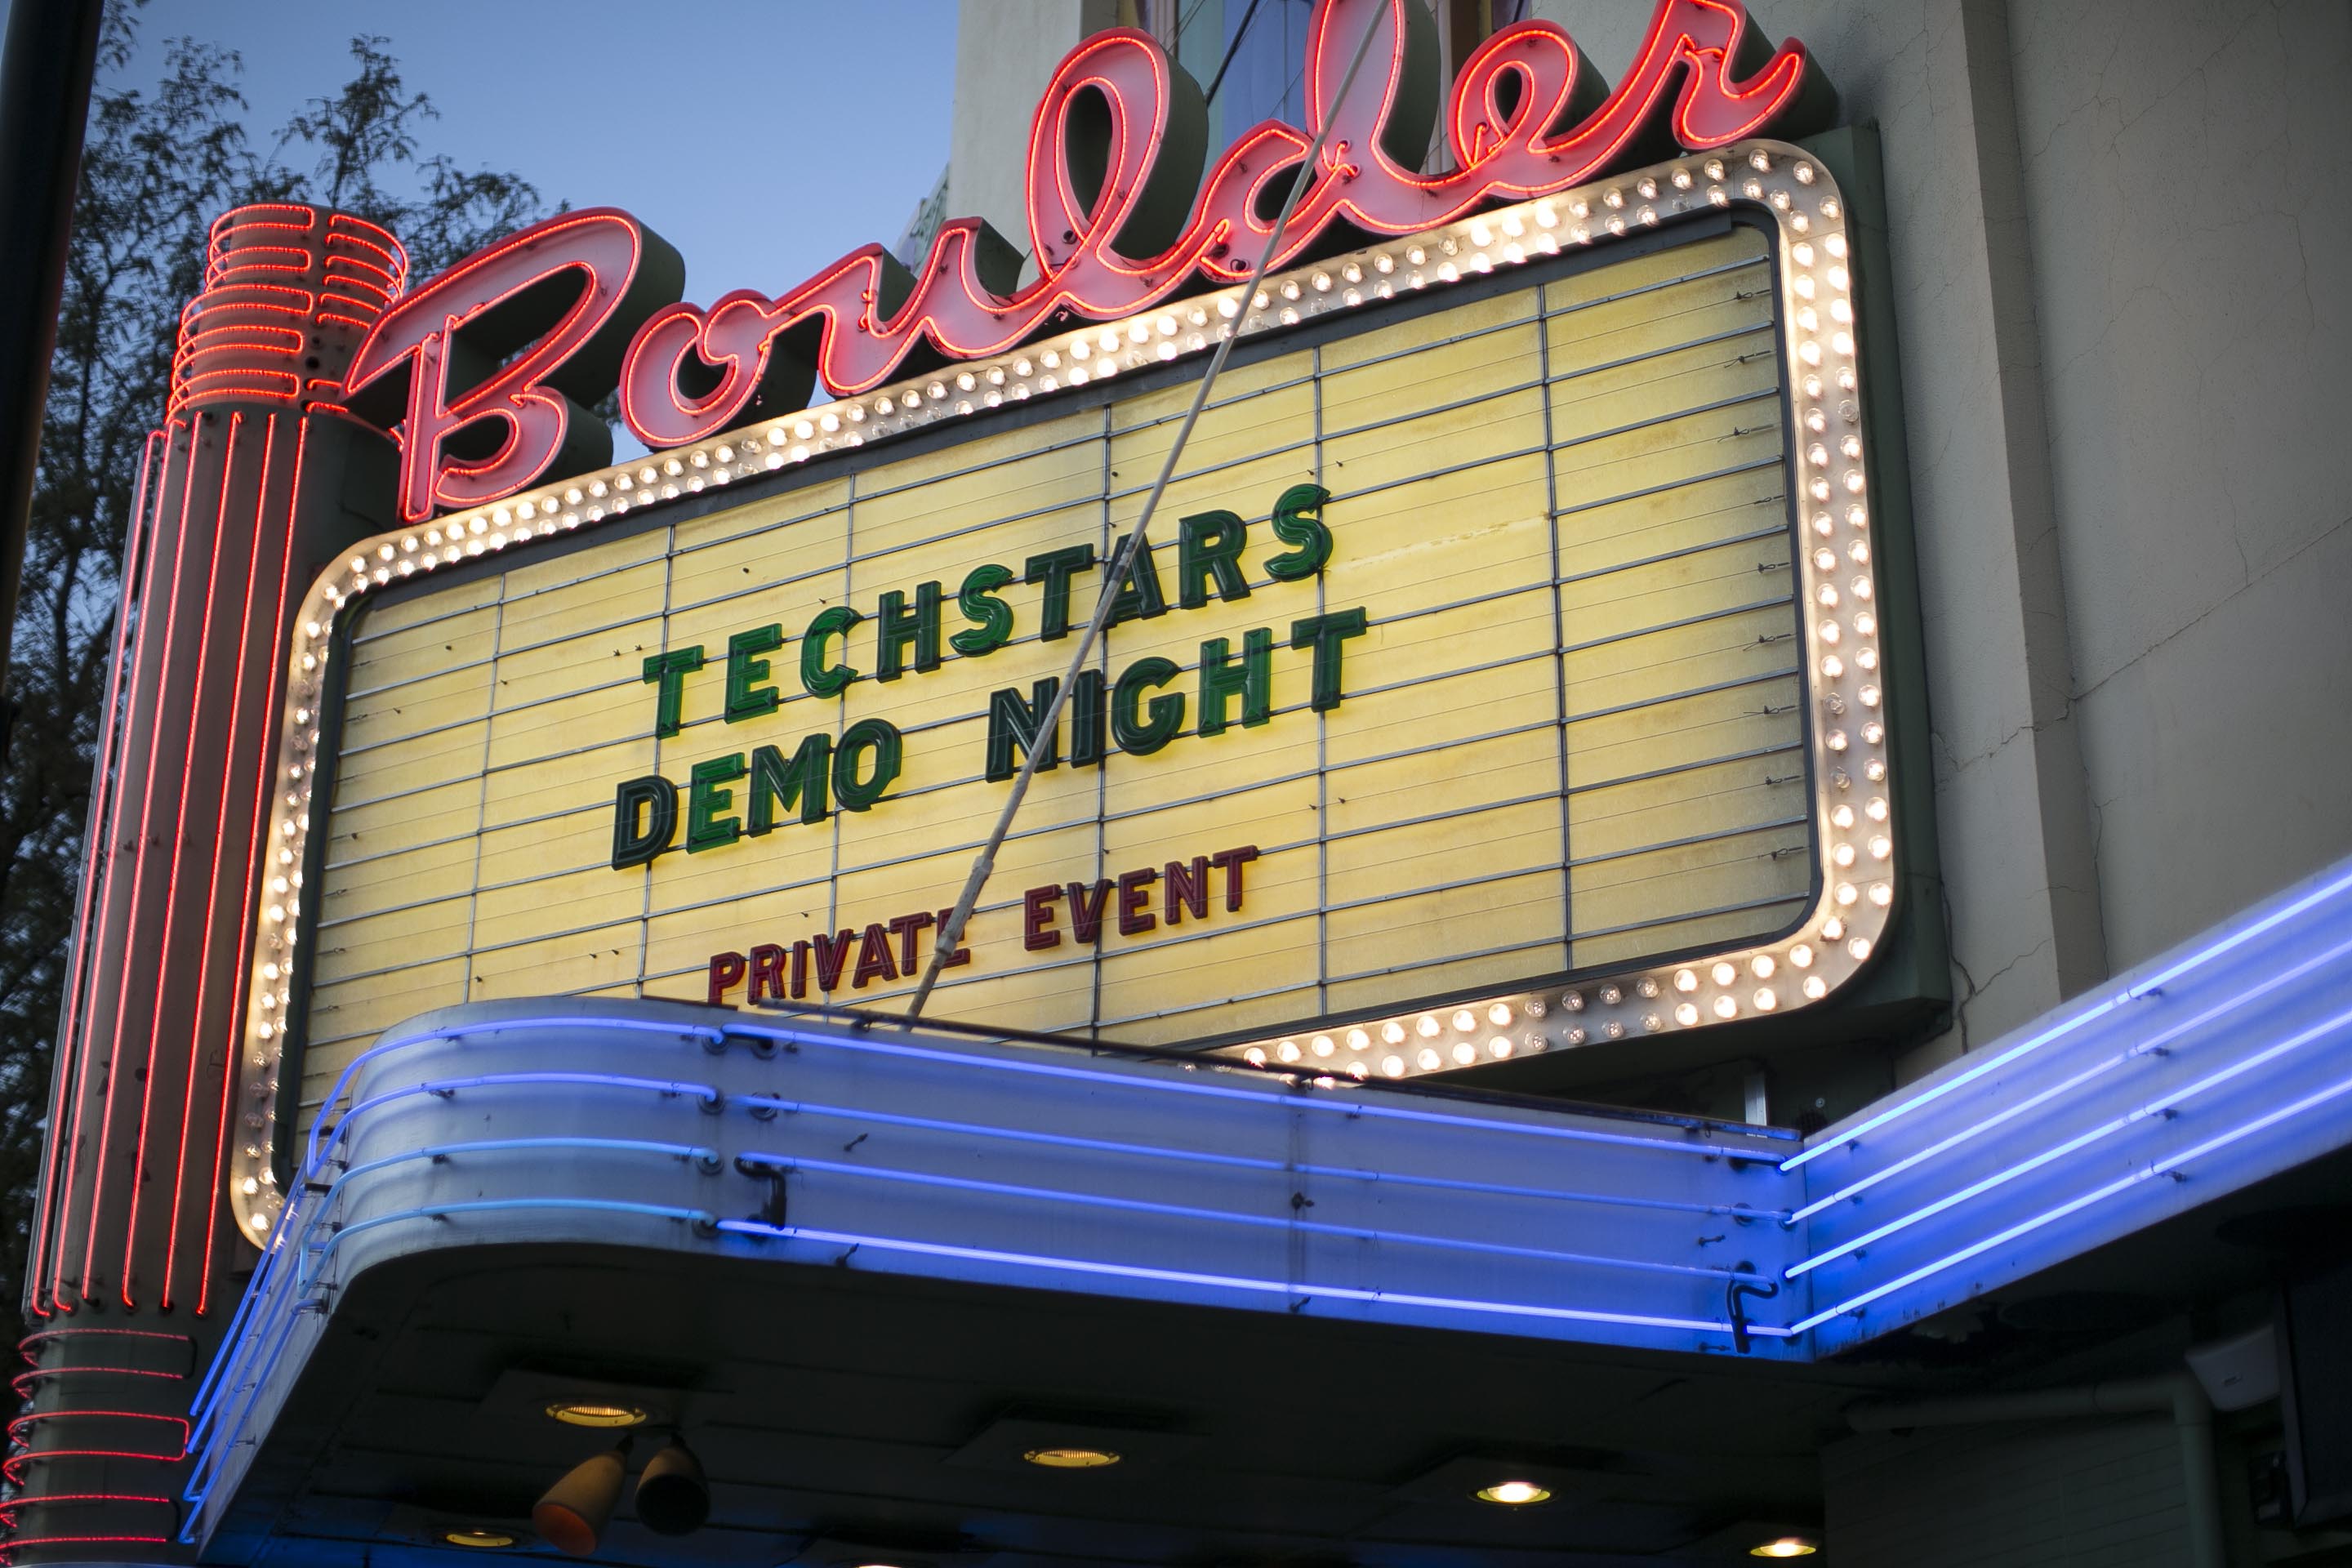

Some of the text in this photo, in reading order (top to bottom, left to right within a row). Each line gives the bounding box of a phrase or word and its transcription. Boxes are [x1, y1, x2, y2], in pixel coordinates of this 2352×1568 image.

[345, 0, 1810, 522] Boulder
[611, 606, 1367, 871] DEMO NIGHT
[643, 483, 1334, 739] TECHSTARS
[1024, 844, 1258, 951] EVENT
